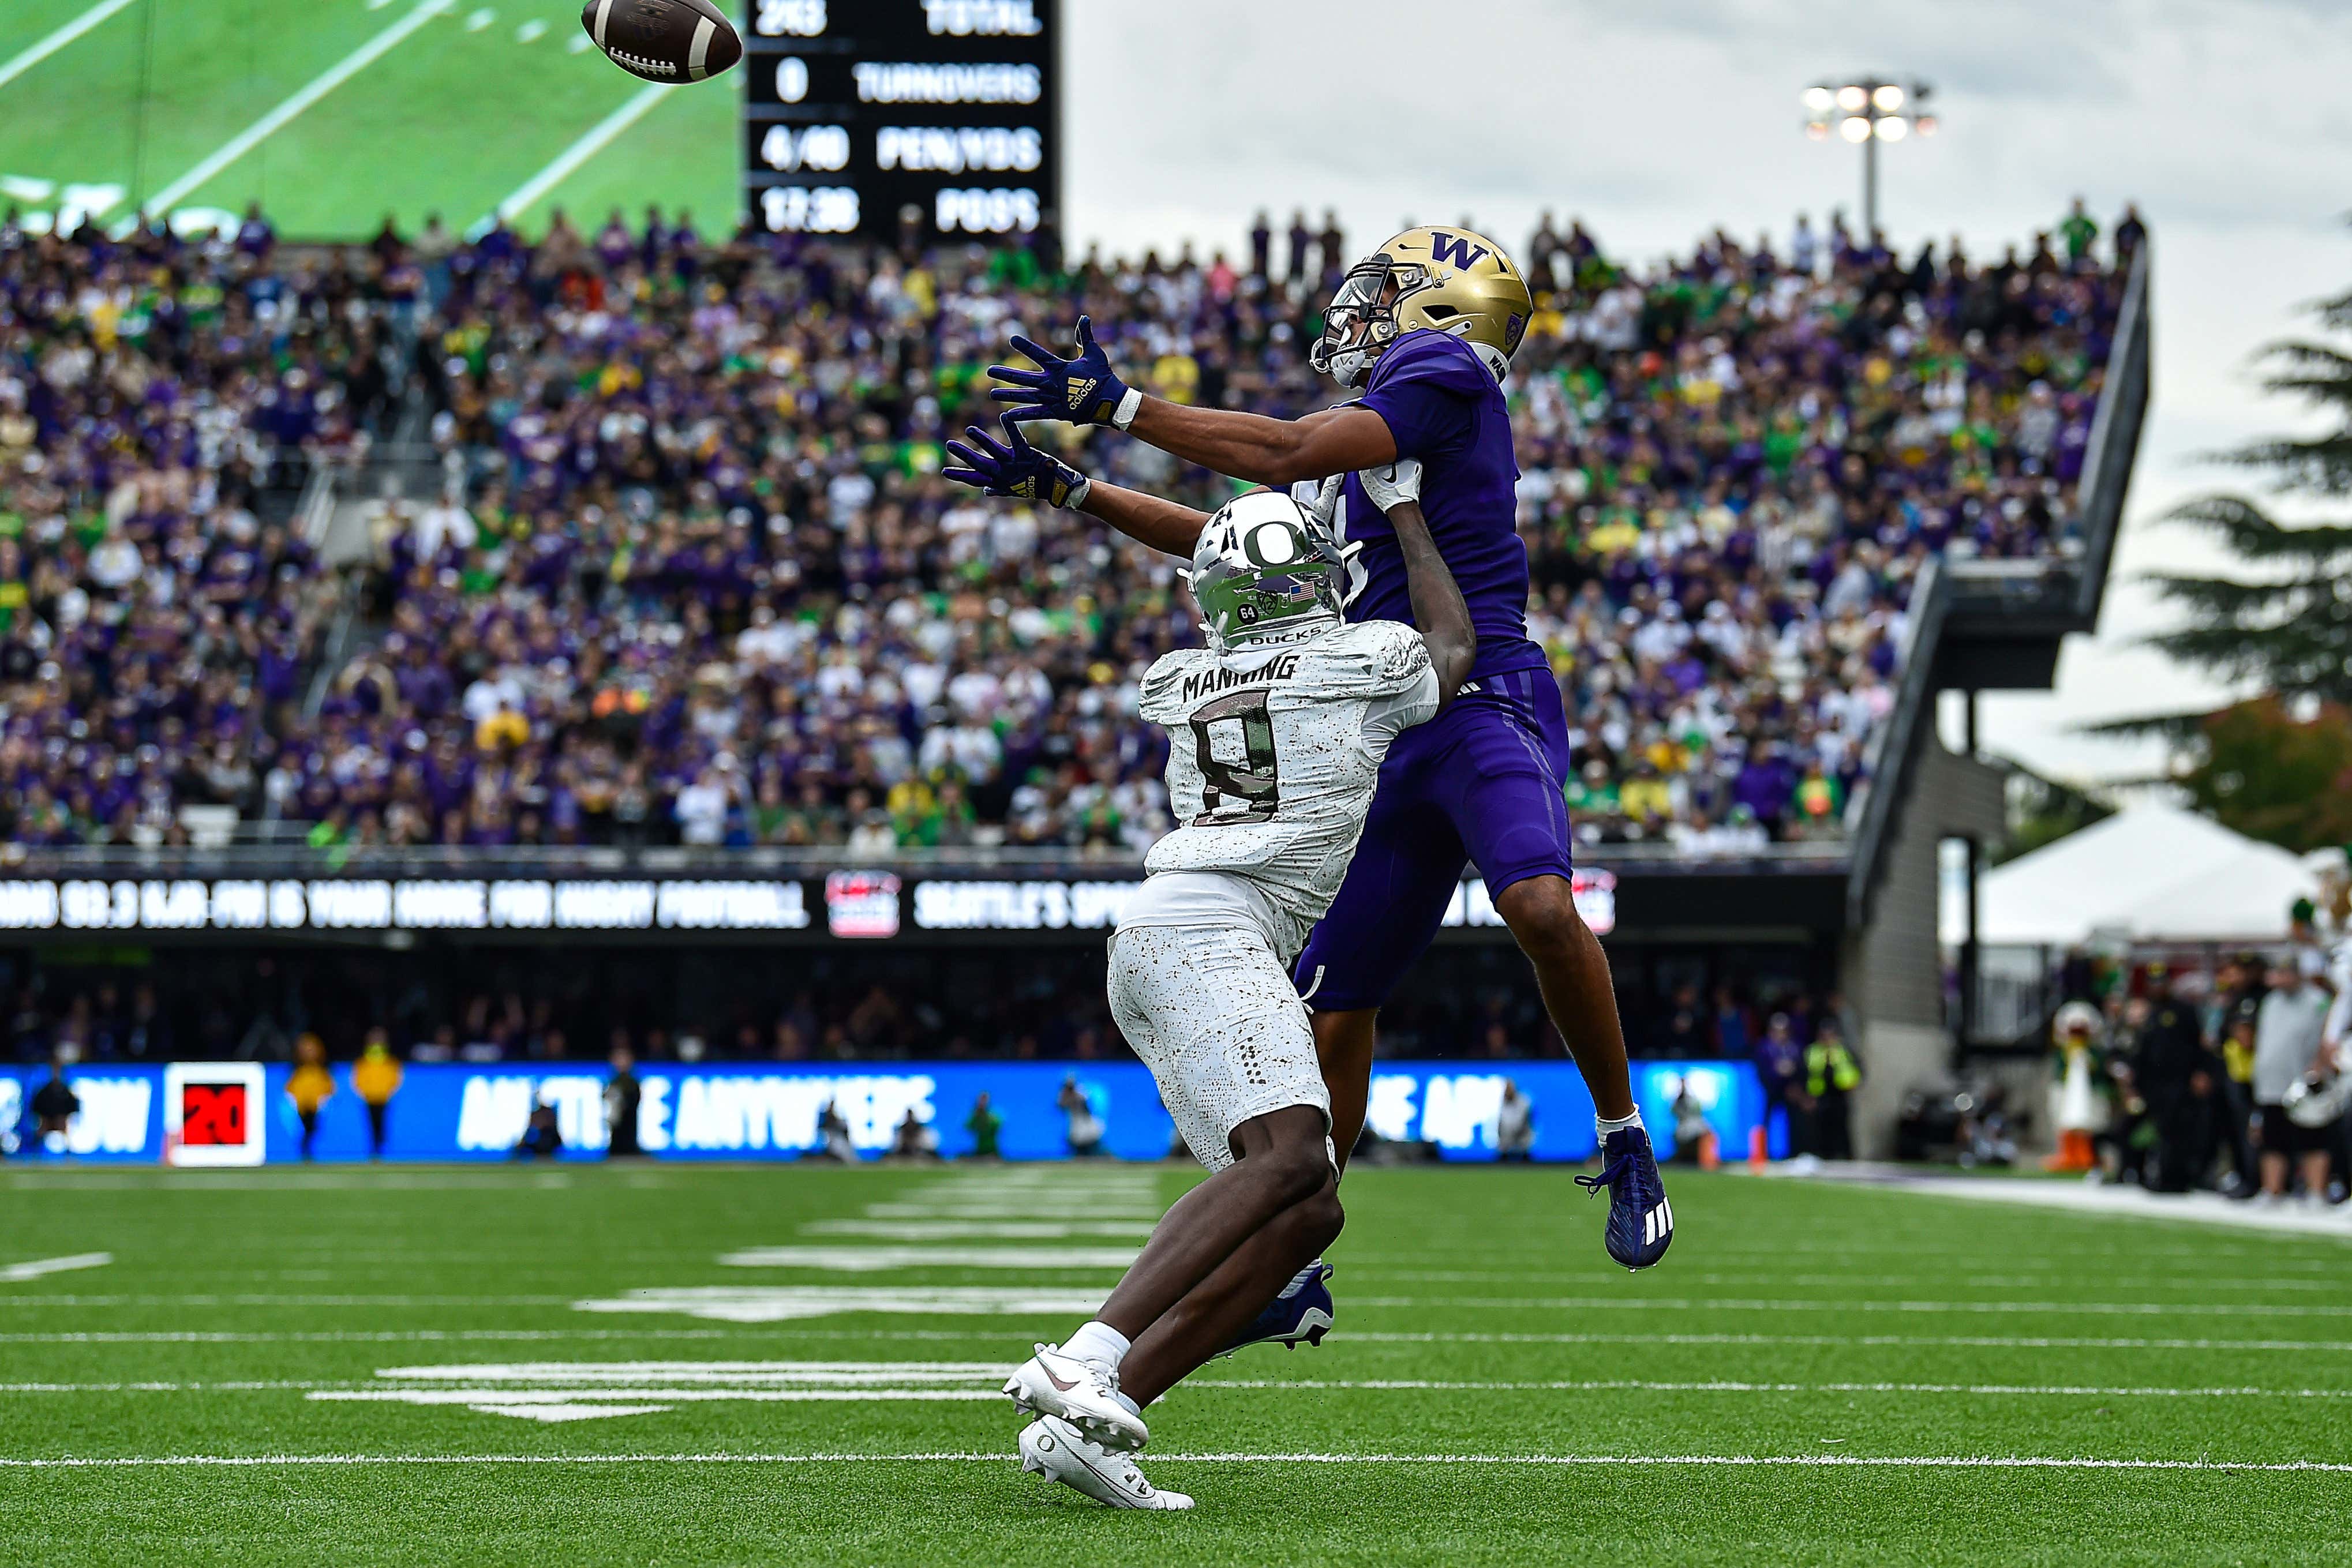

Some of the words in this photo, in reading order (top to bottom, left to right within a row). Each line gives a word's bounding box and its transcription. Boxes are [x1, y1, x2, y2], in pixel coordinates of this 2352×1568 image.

[922, 0, 1041, 36] TOTAL
[853, 62, 1040, 103] TURNOVERS
[935, 188, 1040, 233] POSS
[1428, 231, 1490, 272] W
[1069, 377, 1097, 410] adidas
[1240, 606, 1256, 619] 64
[1250, 626, 1322, 646] DUCKS
[657, 880, 809, 928] FOOTBALL
[183, 1085, 245, 1144] 20
